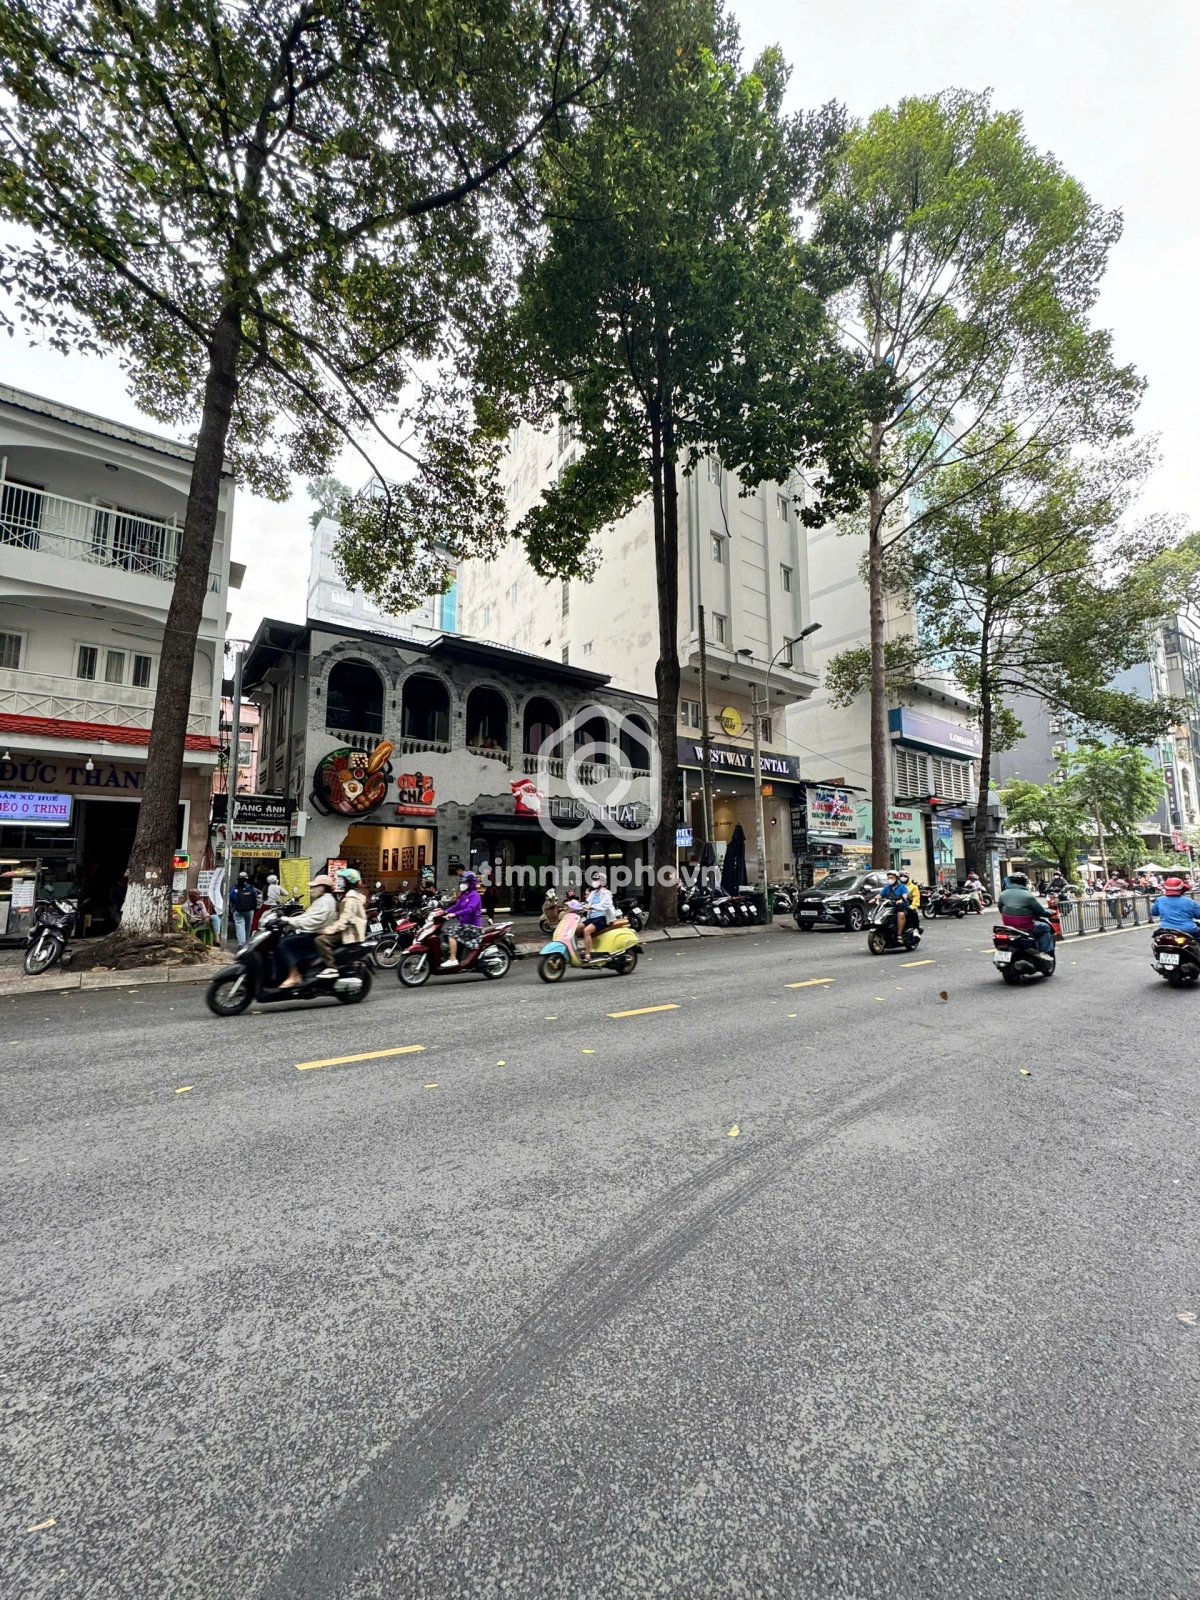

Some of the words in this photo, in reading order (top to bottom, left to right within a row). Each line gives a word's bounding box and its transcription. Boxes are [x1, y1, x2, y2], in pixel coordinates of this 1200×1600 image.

[693, 746, 747, 767] WSTWAY
[0, 757, 57, 785] ĐỨC
[65, 764, 147, 791] THÀN
[22, 803, 29, 813] O
[33, 804, 67, 814] TRINH
[265, 804, 286, 813] ANH
[550, 799, 585, 819] THIS
[600, 804, 640, 821] THAT
